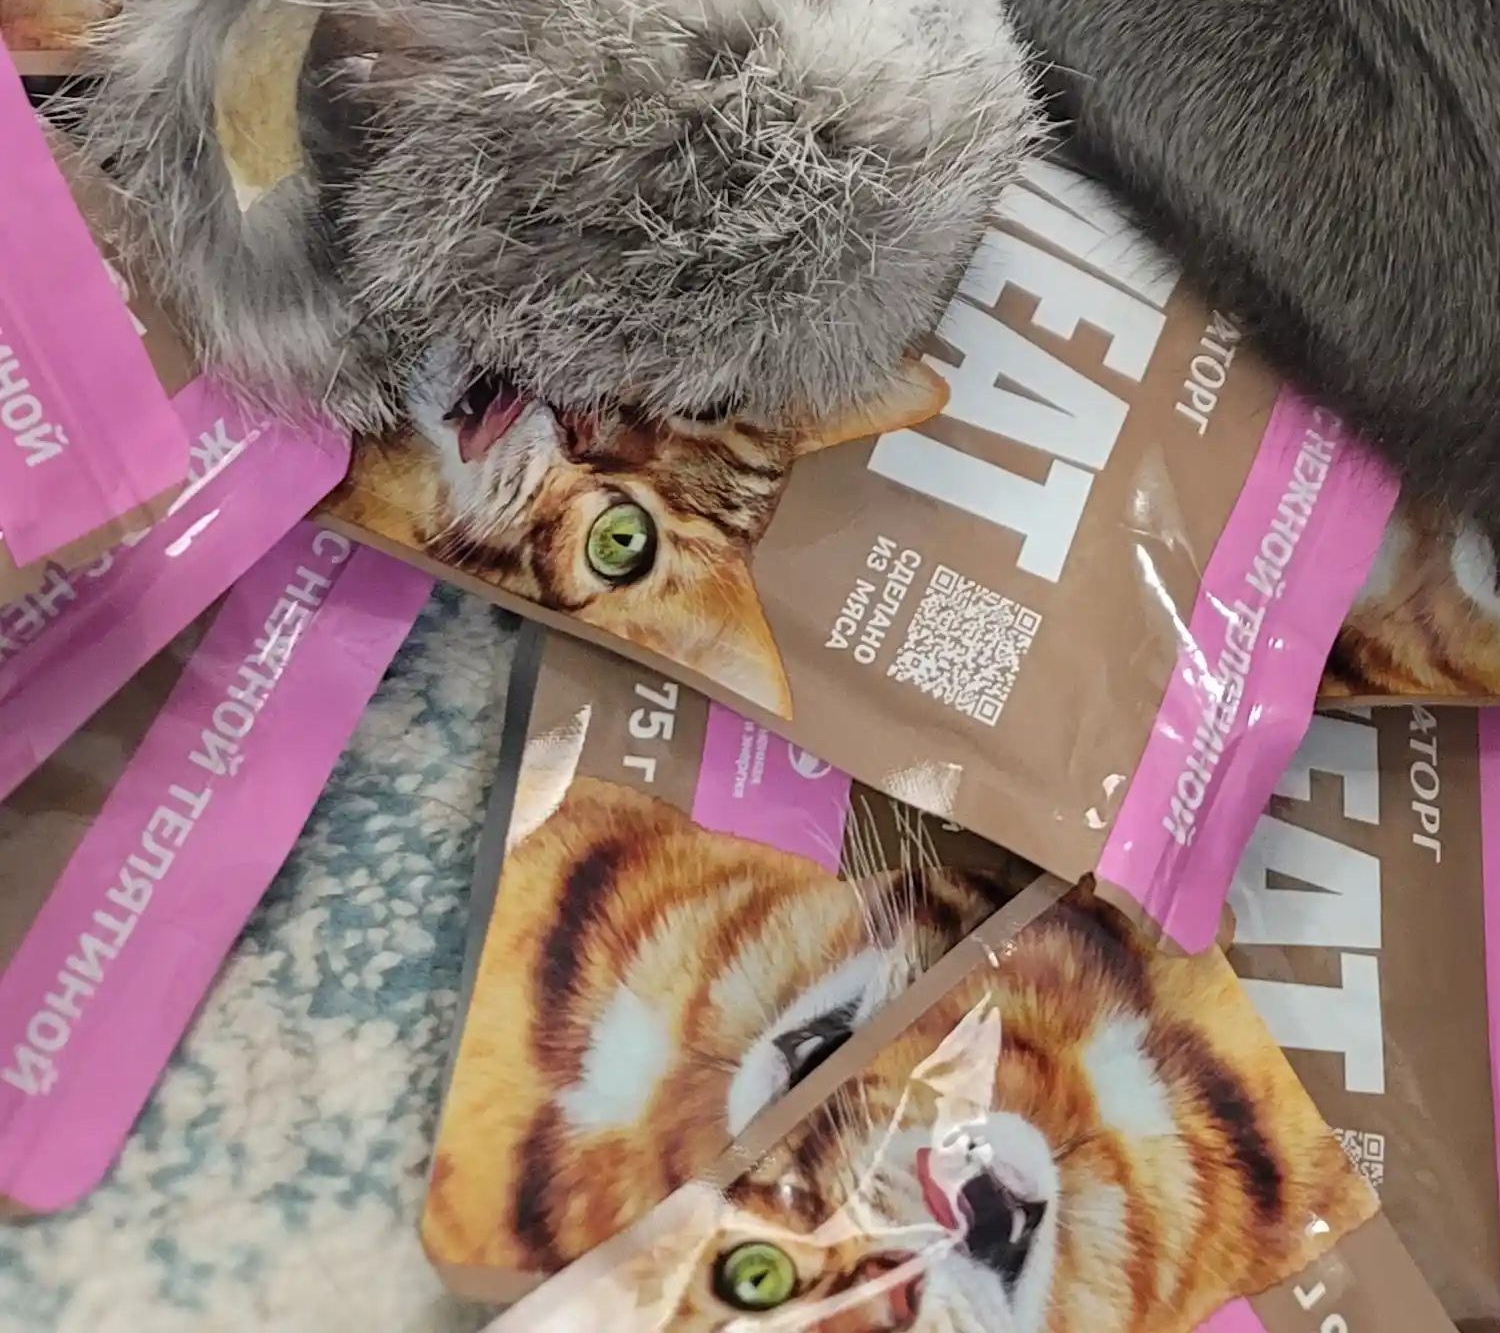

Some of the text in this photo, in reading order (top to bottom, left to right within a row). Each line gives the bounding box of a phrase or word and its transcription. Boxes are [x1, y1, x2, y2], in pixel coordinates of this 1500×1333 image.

[311, 529, 352, 565] С
[1246, 429, 1337, 600] НЕЖНОЙ
[824, 535, 898, 650] ИЗ МЯСА
[854, 549, 922, 665] СДЕЛАНО
[188, 565, 334, 778] НЕЖНОЙ
[628, 681, 679, 744] 75
[2, 780, 213, 1098] ТЕЛЯТИНОЙ
[1224, 705, 1386, 1095] EAT
